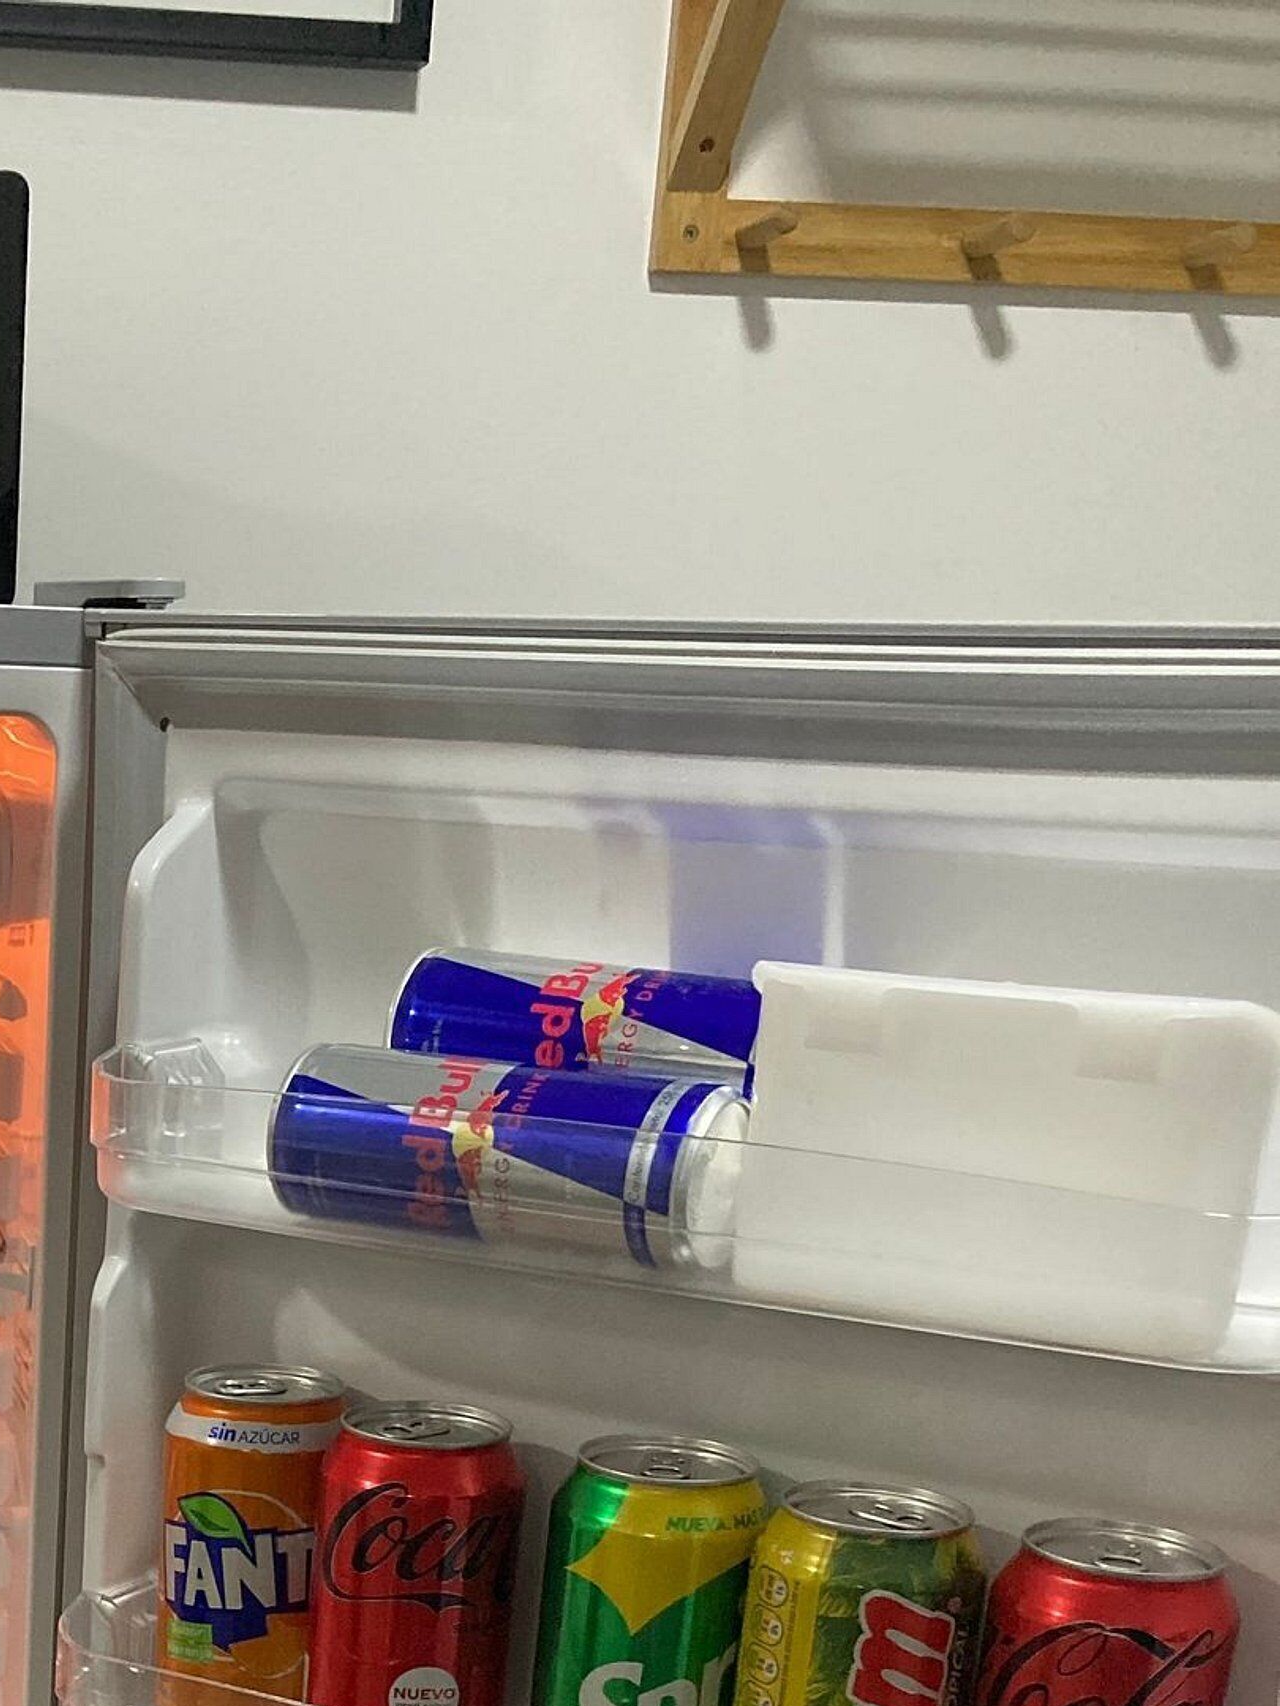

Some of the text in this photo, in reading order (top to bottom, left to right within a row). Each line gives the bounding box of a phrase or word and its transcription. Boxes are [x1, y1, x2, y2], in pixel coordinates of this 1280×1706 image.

[530, 962, 603, 1068] ed Bu
[615, 1007, 644, 1068] ERGY
[408, 1056, 488, 1129] Bull
[209, 1422, 300, 1445] sin AZÚCAR
[166, 1523, 314, 1611] FANT
[393, 1687, 455, 1700] NUEVO
